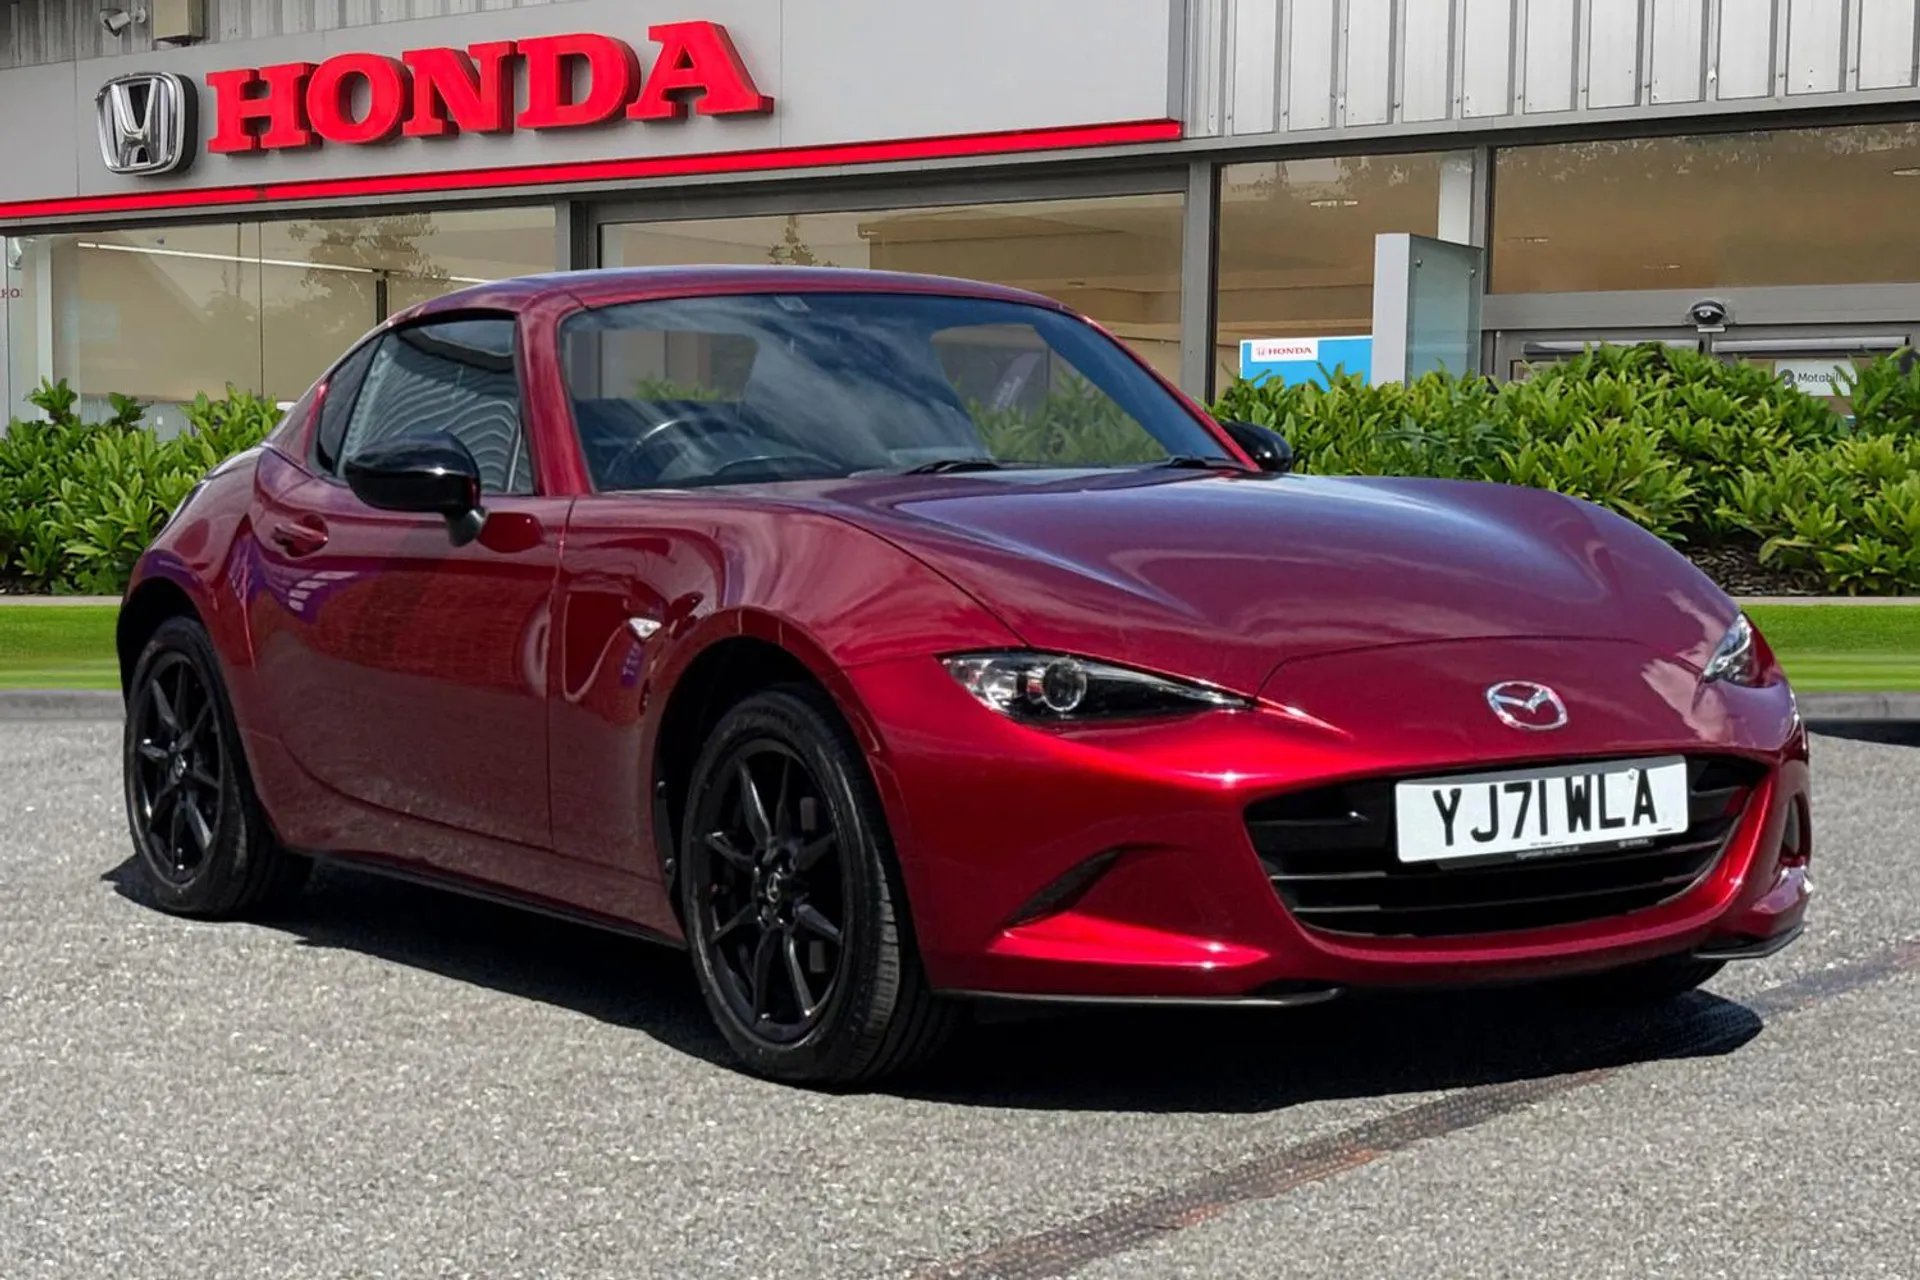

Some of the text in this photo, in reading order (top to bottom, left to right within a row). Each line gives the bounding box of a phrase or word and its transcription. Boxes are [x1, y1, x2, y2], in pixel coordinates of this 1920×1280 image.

[206, 20, 774, 154] HONDA
[1268, 346, 1313, 356] HONDA
[1432, 768, 1658, 847] YJ71 WLA
